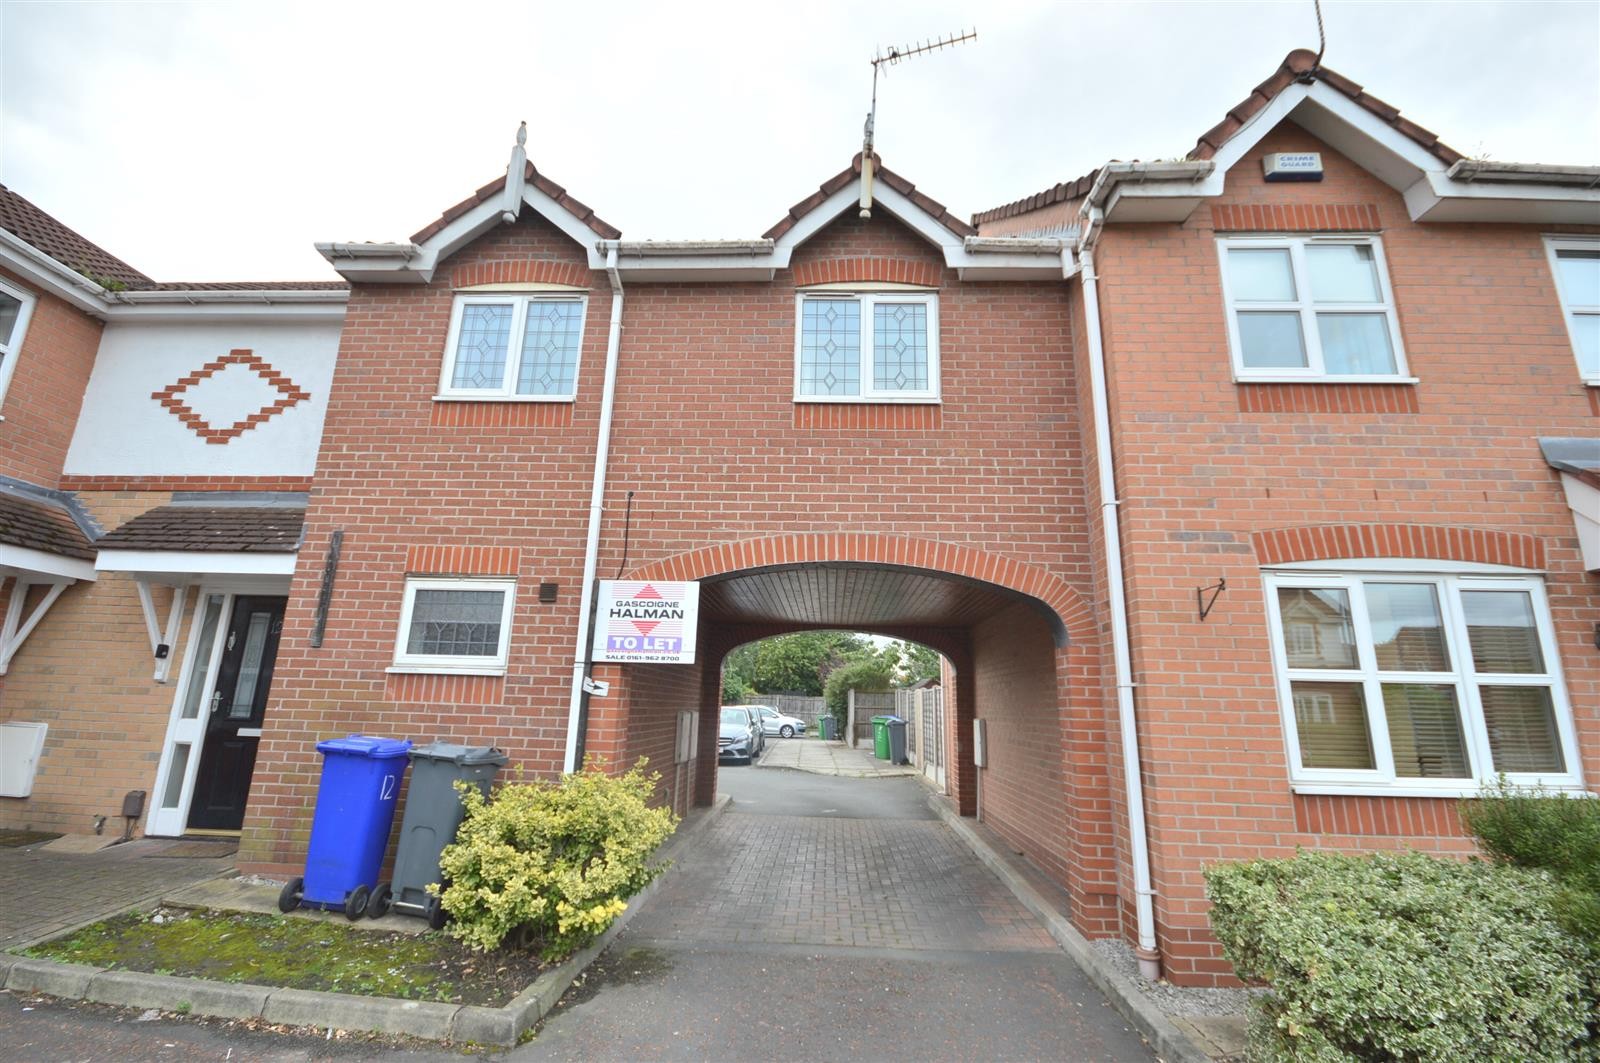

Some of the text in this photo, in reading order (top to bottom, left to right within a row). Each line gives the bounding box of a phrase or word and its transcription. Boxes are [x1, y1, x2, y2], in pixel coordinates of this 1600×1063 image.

[615, 600, 679, 608] GASCOIGNE
[609, 609, 684, 619] HALMAN
[612, 637, 677, 650] TO LET
[380, 775, 395, 800] 12
